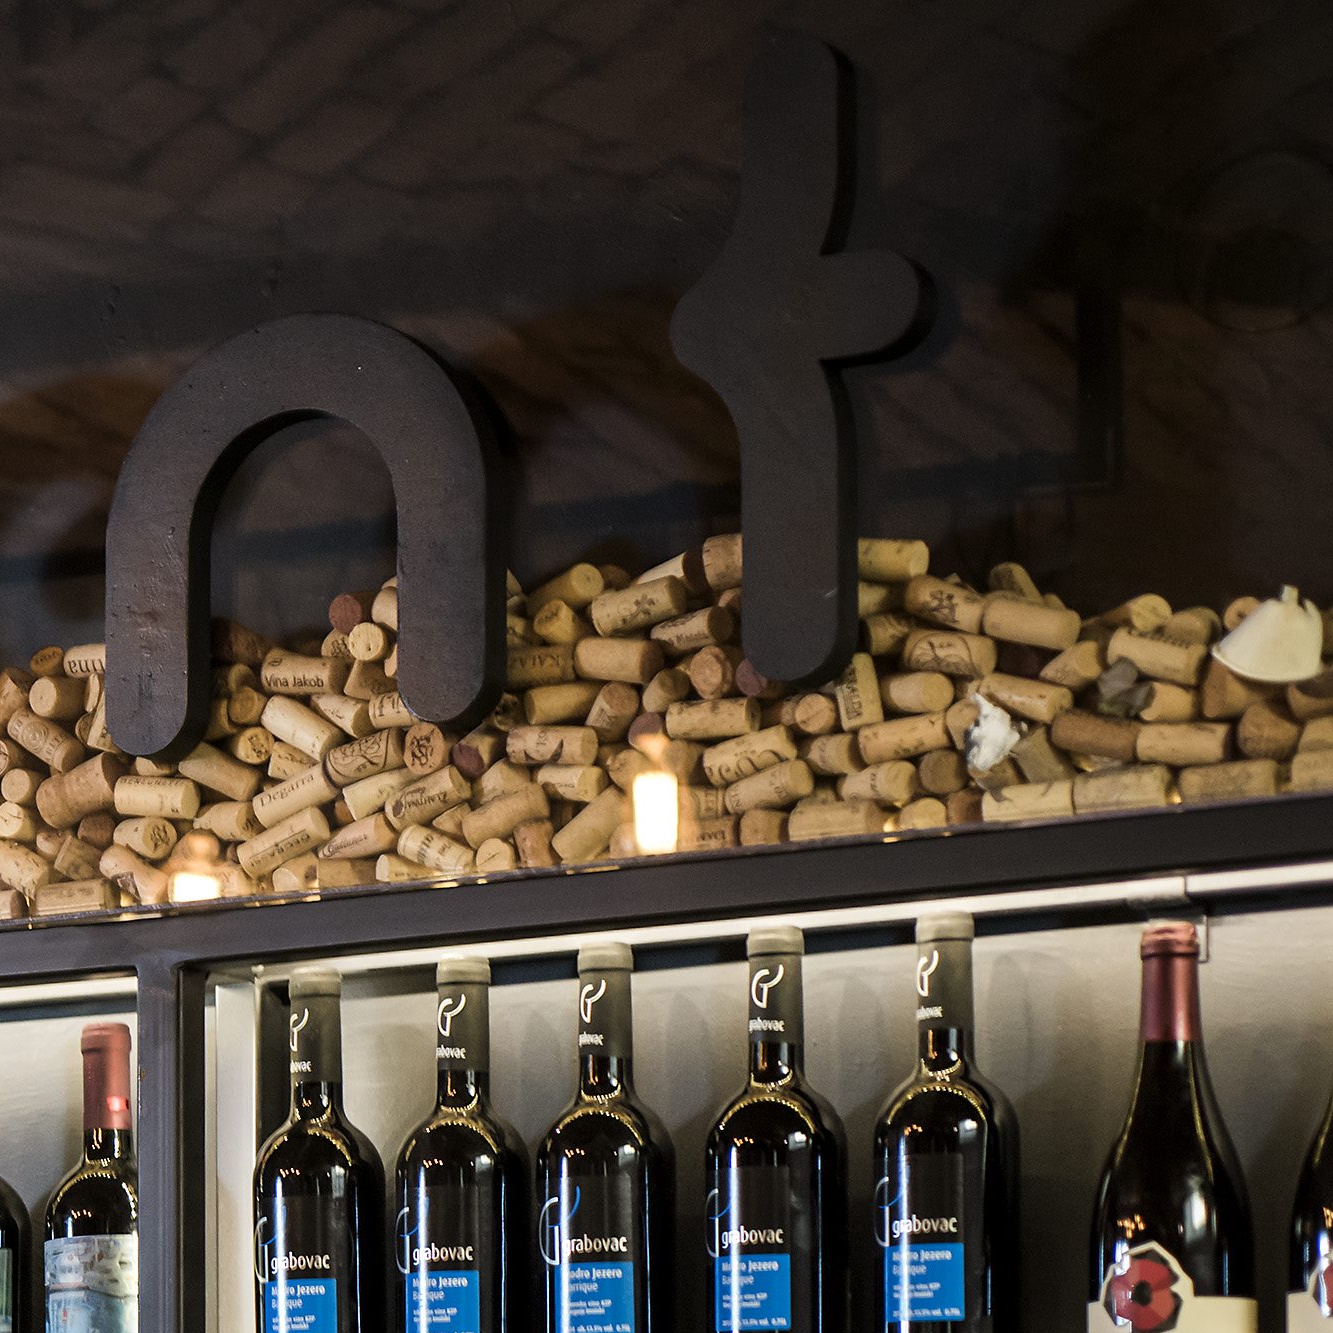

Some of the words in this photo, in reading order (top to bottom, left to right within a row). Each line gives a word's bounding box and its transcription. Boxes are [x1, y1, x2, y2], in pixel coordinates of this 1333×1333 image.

[265, 675, 290, 690] Vina
[291, 674, 325, 690] Jakob
[412, 1242, 474, 1266] gabovac
[920, 1249, 952, 1263] Jezero
[271, 1251, 330, 1274] gabovac
[748, 1260, 779, 1274] Jezero
[592, 1267, 623, 1281] Jezero
[438, 1276, 468, 1290] Jezero
[297, 1284, 326, 1297] Jezero
